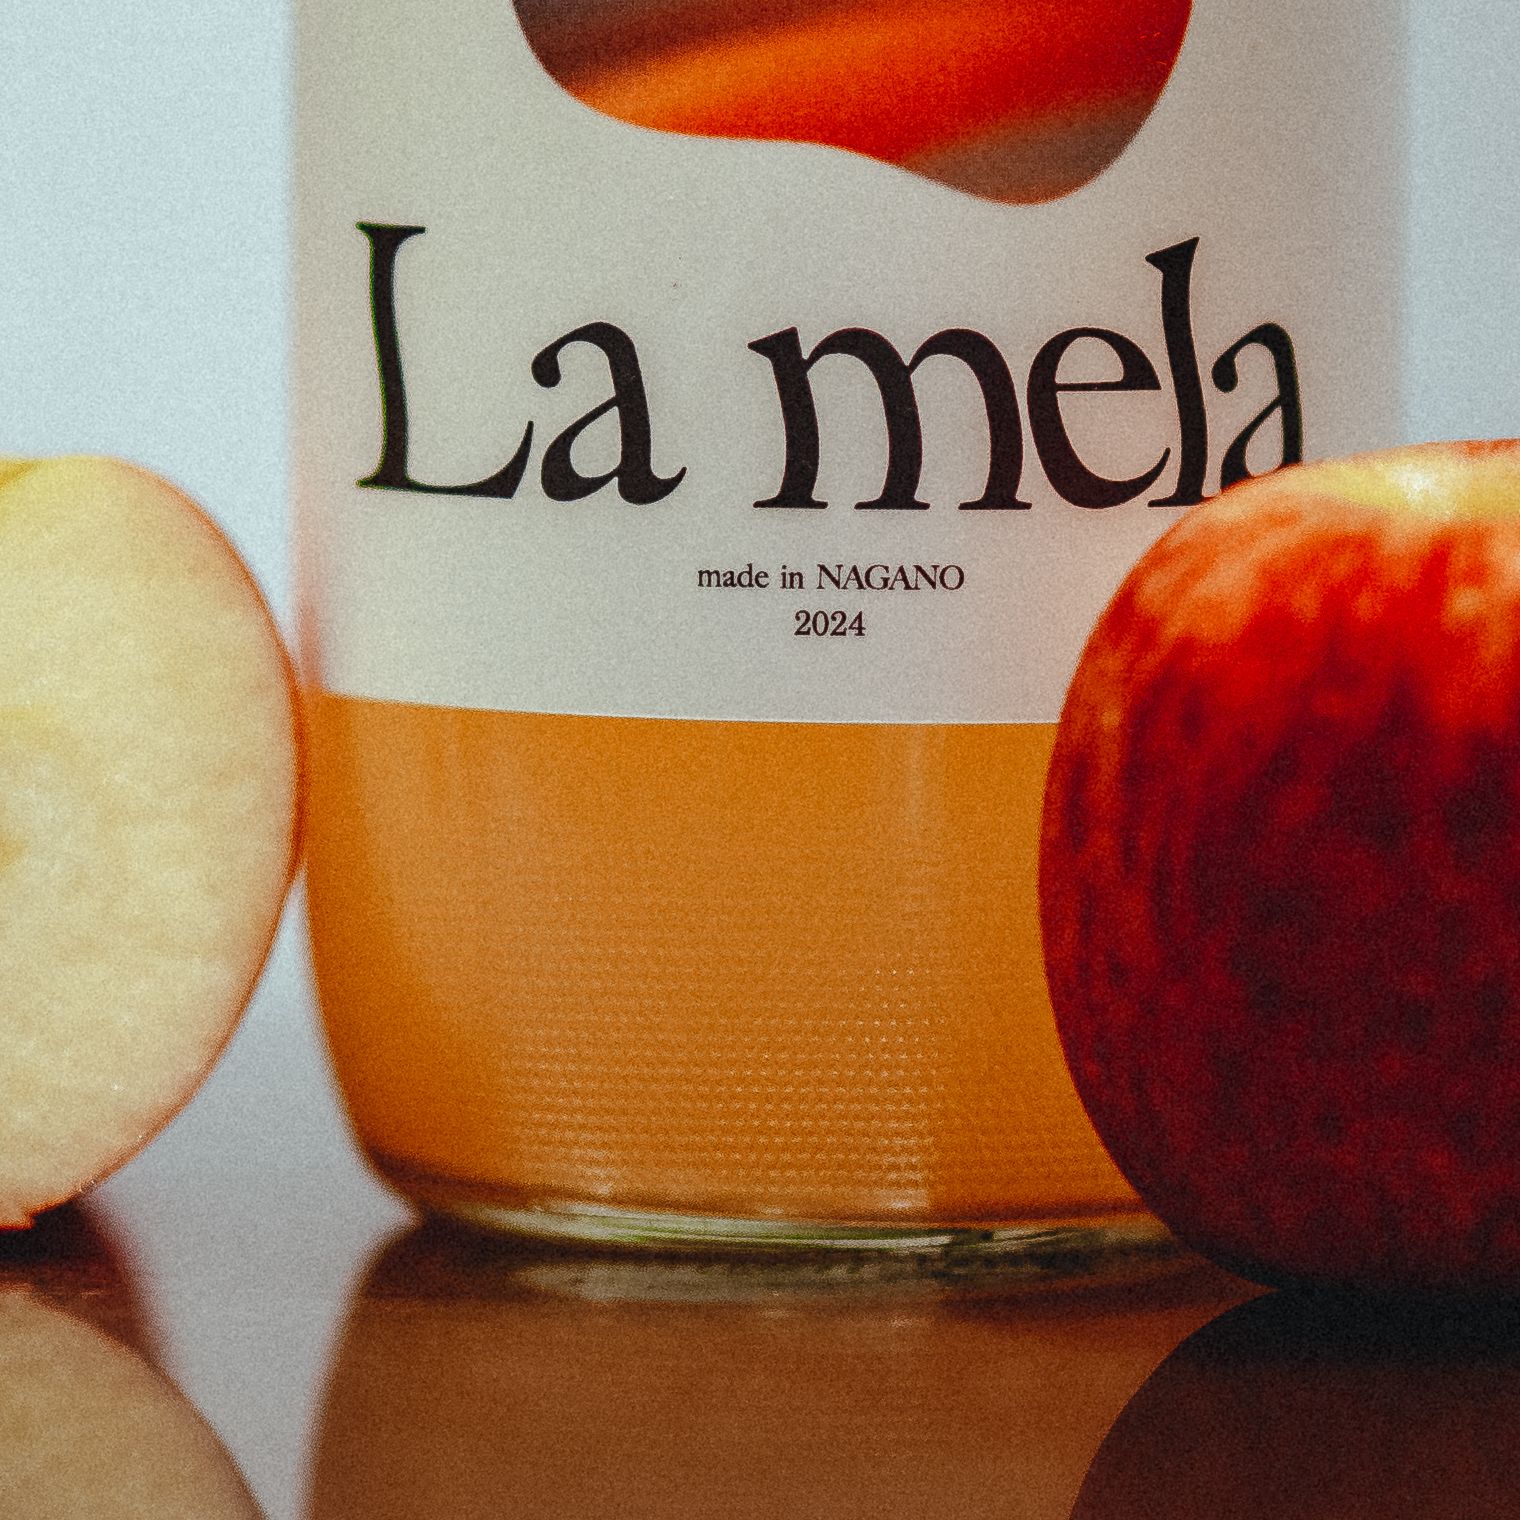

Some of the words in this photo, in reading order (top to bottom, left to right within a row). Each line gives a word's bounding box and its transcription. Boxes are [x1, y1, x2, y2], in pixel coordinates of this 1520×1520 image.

[356, 221, 688, 507] La
[746, 235, 1304, 512] mela
[696, 562, 770, 590] made
[780, 564, 806, 591] in
[815, 563, 966, 592] NAGANO
[793, 608, 867, 638] 2024
